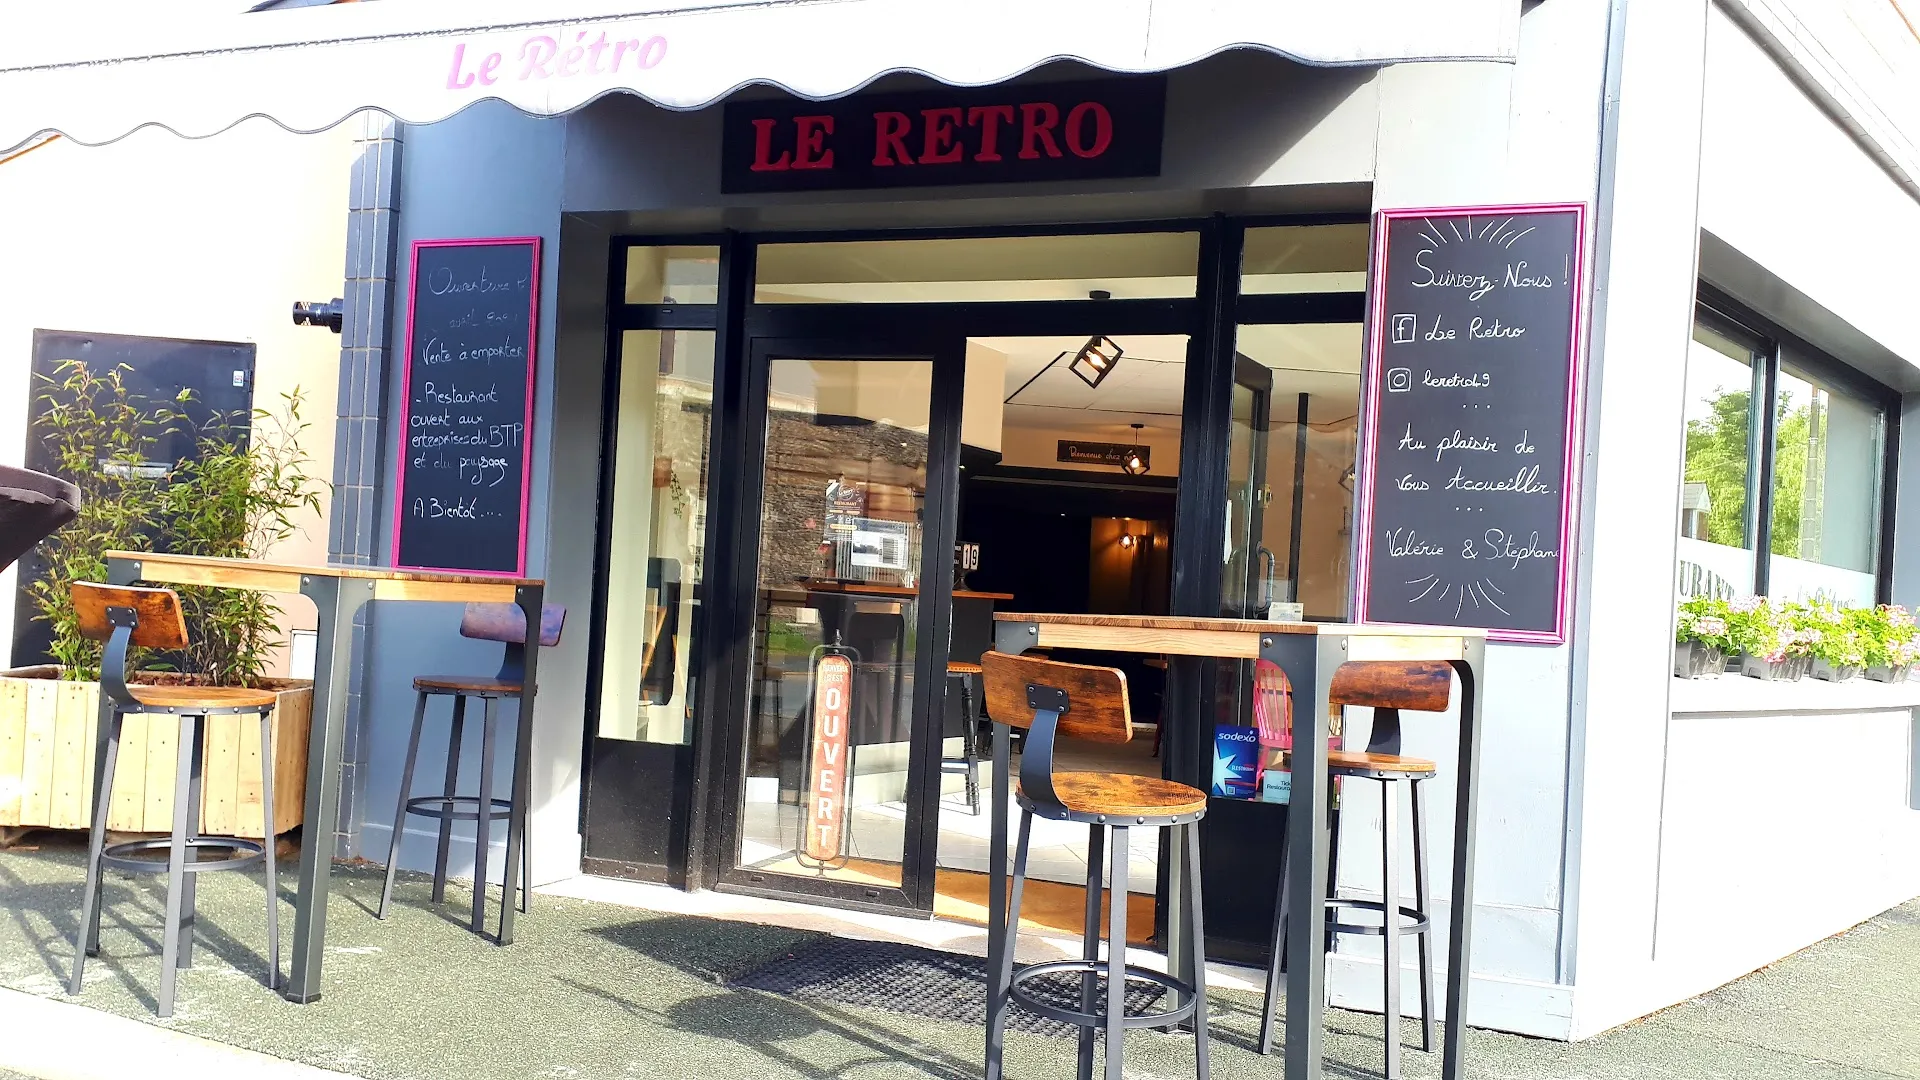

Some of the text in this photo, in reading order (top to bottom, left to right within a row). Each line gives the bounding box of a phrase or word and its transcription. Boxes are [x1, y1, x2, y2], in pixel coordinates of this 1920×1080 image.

[445, 30, 668, 90] Le Rétro
[750, 101, 1113, 172] LE RETRO
[1425, 314, 1456, 341] Le
[1469, 316, 1526, 341] Rétro
[422, 335, 525, 366] Vente à emporter
[425, 381, 499, 404] Restaurant
[411, 408, 483, 428] ouvert aux
[489, 422, 523, 448] BTP
[1398, 422, 1535, 462] Au plaisir de
[1069, 445, 1102, 460] Bienvenue
[1105, 447, 1121, 461] chez
[413, 452, 426, 469] et
[459, 455, 508, 488] paysage
[413, 497, 424, 519] A
[1386, 527, 1444, 558] Valérie
[1461, 538, 1479, 559] &
[1217, 730, 1257, 743] sodexo
[817, 687, 841, 848] OUVERT
